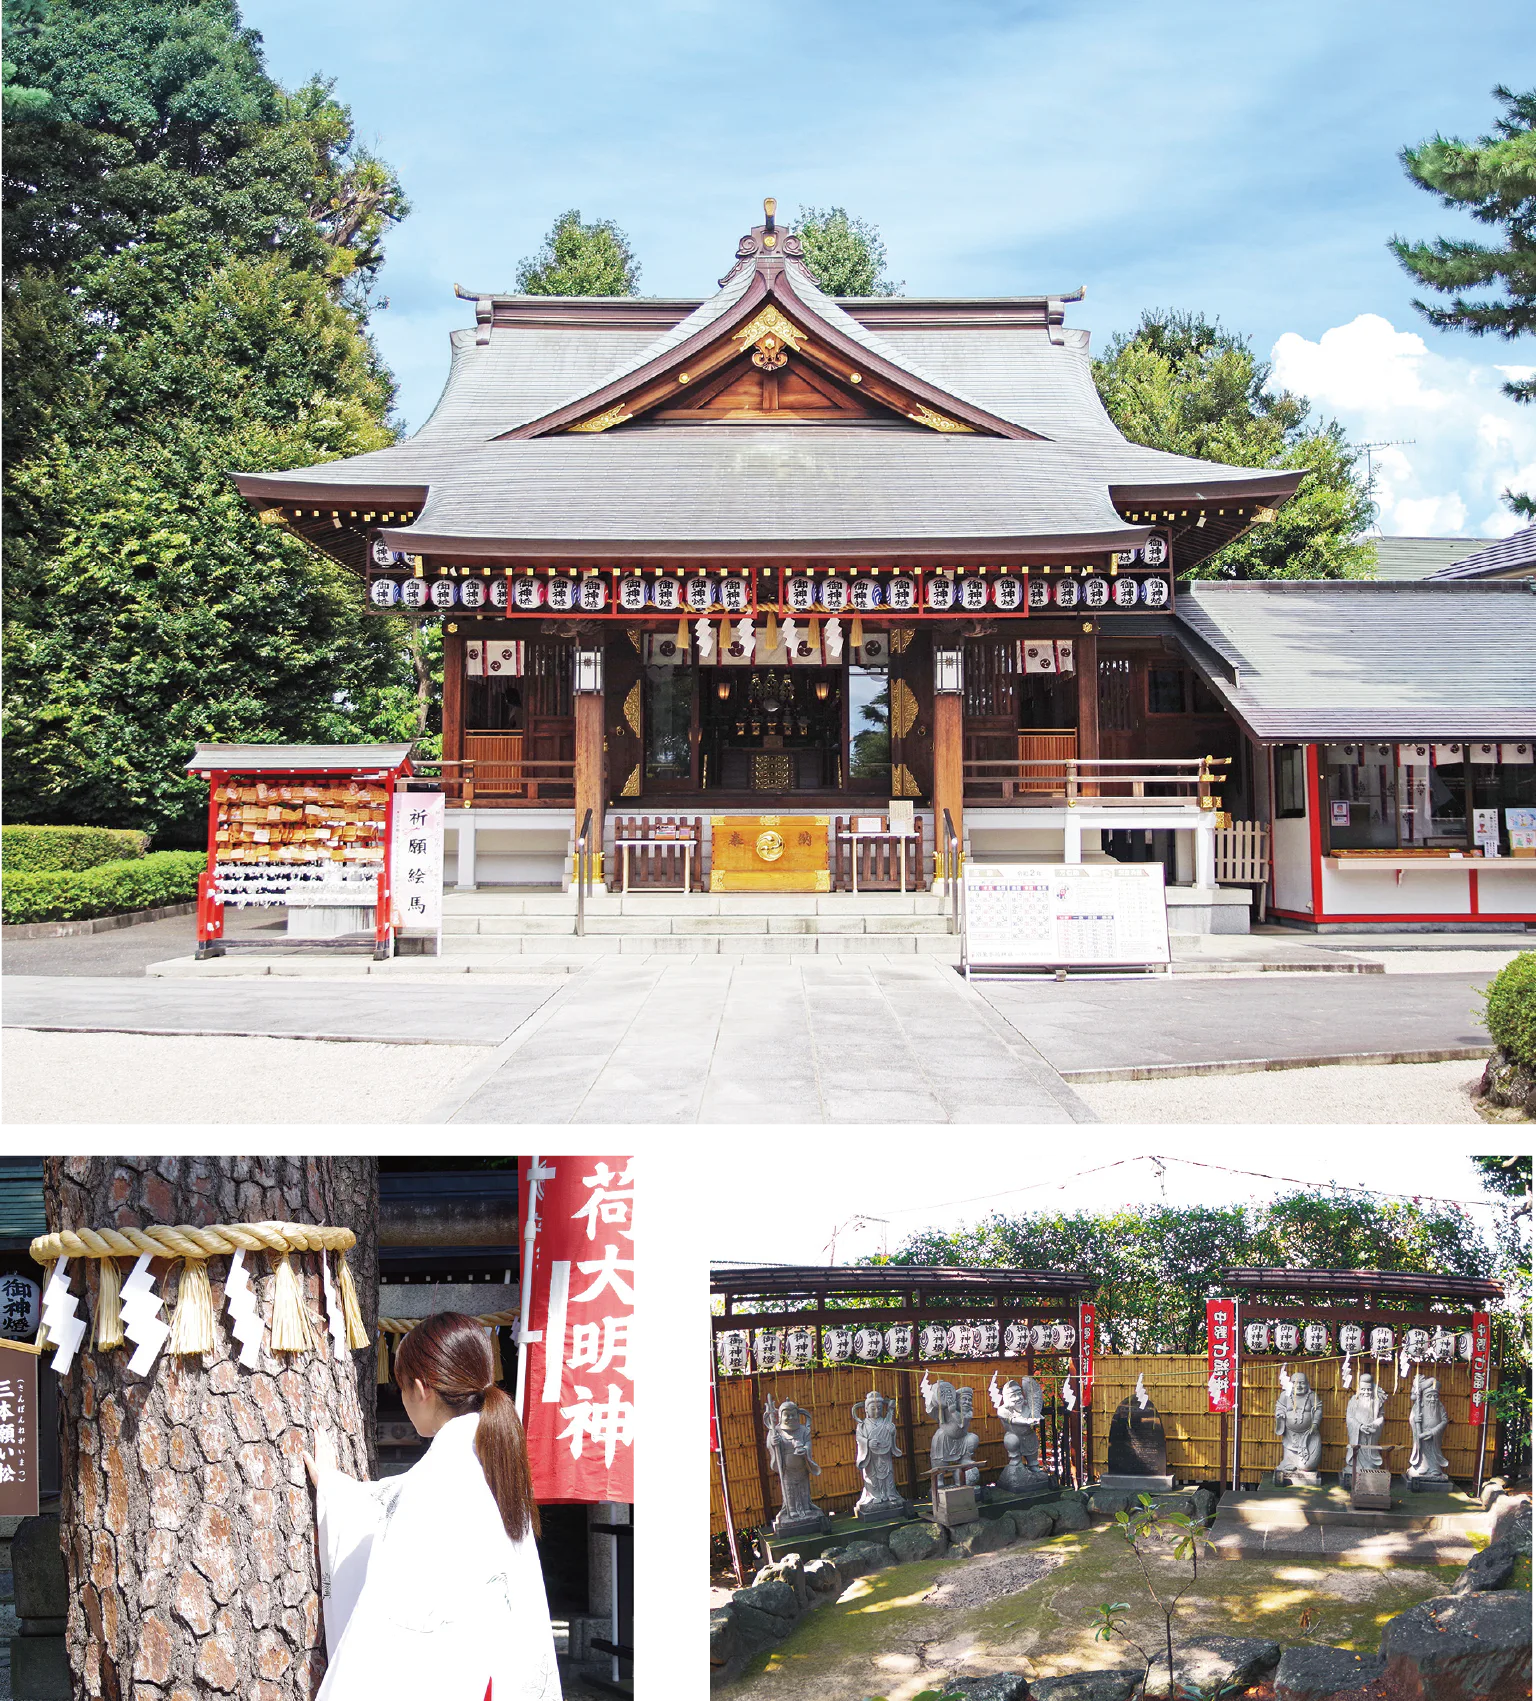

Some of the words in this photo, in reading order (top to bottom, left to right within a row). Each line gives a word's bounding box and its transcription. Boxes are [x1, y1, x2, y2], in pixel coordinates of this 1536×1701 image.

[1149, 538, 1163, 562] 御神燈
[377, 581, 390, 605] 御神燈
[406, 581, 420, 605] 御神燈
[436, 581, 450, 605] 御神燈
[465, 581, 479, 605] 御神燈
[518, 579, 533, 606] 御神燈
[552, 579, 567, 606] 御神燈
[584, 580, 600, 607] 御神燈
[625, 578, 641, 606] 御神燈
[658, 579, 674, 607] 御神燈
[691, 579, 707, 606] 御神燈
[725, 579, 741, 607] 御神燈
[792, 578, 808, 607] 御神燈
[826, 578, 842, 607] 御神燈
[853, 579, 868, 607] 御神燈
[894, 578, 910, 606] 御神燈
[933, 578, 949, 606] 御神燈
[967, 578, 983, 606] 御神燈
[1000, 578, 1016, 607] 御神燈
[1030, 581, 1044, 605] 御神燈
[1061, 581, 1075, 605] 御神燈
[1089, 580, 1104, 605] 御神燈
[1120, 580, 1134, 605] 御神燈
[1150, 580, 1164, 605] 御神燈
[408, 809, 428, 914] 祈願絵馬
[2, 1278, 32, 1332] 御神燈
[556, 1158, 637, 1470] 荷大明神
[762, 1335, 776, 1364] 御神燈
[835, 1330, 849, 1358] 御神燈
[866, 1330, 880, 1357] 御神燈
[894, 1328, 908, 1354] 御神燈
[931, 1325, 945, 1352] 御神燈
[959, 1325, 972, 1352] 御神燈
[985, 1325, 997, 1351] 御神燈
[1016, 1325, 1029, 1350] 御神燈
[1063, 1325, 1075, 1348] 御神燈
[1251, 1324, 1264, 1349] 御神燈
[1280, 1324, 1293, 1349] 御神燈
[1310, 1324, 1324, 1349] 御神燈
[1345, 1325, 1358, 1350] 御神燈
[728, 1336, 743, 1367] 御神燈
